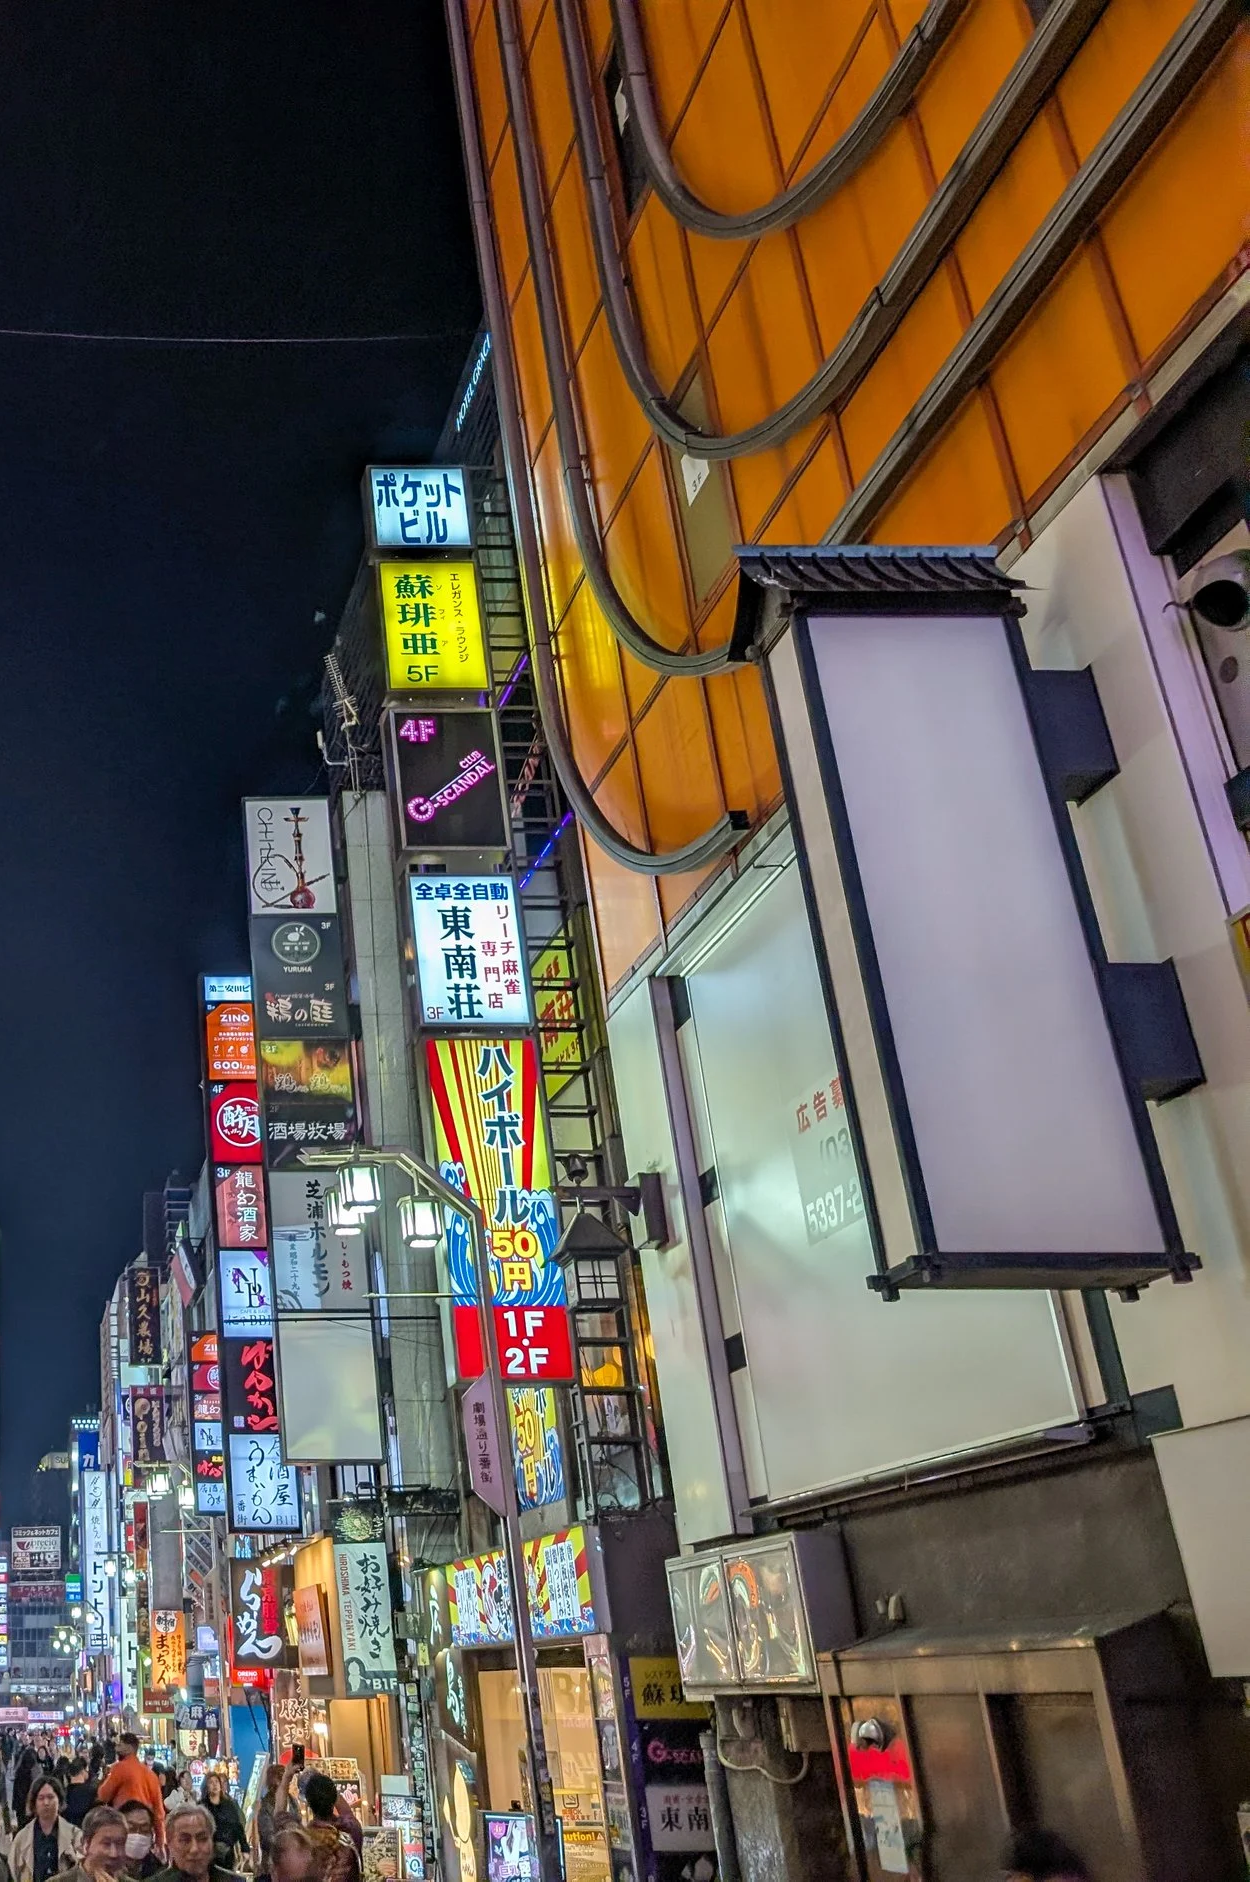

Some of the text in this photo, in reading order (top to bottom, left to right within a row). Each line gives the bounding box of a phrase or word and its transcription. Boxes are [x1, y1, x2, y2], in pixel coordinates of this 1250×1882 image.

[376, 473, 462, 508] ポケット
[400, 512, 448, 544] ビル
[394, 574, 440, 656] 蘇琲亜
[449, 573, 469, 663] エレガンス・ラウンジ
[407, 666, 438, 682] 5F
[400, 719, 436, 742] 4F
[459, 750, 481, 770] CLUB
[415, 883, 509, 901] 全卓全自動
[437, 905, 483, 1020] 東南荘
[496, 906, 521, 996] リーチ麻雀
[480, 941, 504, 1010] 専門店
[427, 1006, 444, 1020] 3F
[212, 1085, 223, 1093] 4F
[796, 1076, 845, 1134] 広告募
[268, 1122, 347, 1141] 酒場牧場
[476, 1046, 531, 1225] ハイボール
[217, 1167, 231, 1178] 3F
[235, 1171, 259, 1242] 龍幻酒家
[806, 1176, 864, 1235] 5337-2
[305, 1179, 330, 1297] 芝浦ホルモン
[491, 1230, 537, 1259] 50
[502, 1261, 534, 1292] 円
[503, 1310, 545, 1338] 1F
[504, 1347, 549, 1375] 2F
[198, 1404, 220, 1414] 龍幻
[473, 1402, 492, 1484] 劇場通り一番街
[275, 1515, 297, 1526] B1F
[338, 1553, 356, 1651] HIROSHIMA TEPPANYAKI
[355, 1552, 390, 1659] お好み焼き
[156, 1634, 171, 1685] まっちゃん
[373, 1678, 397, 1690] B1F
[661, 1807, 709, 1832] 東南
